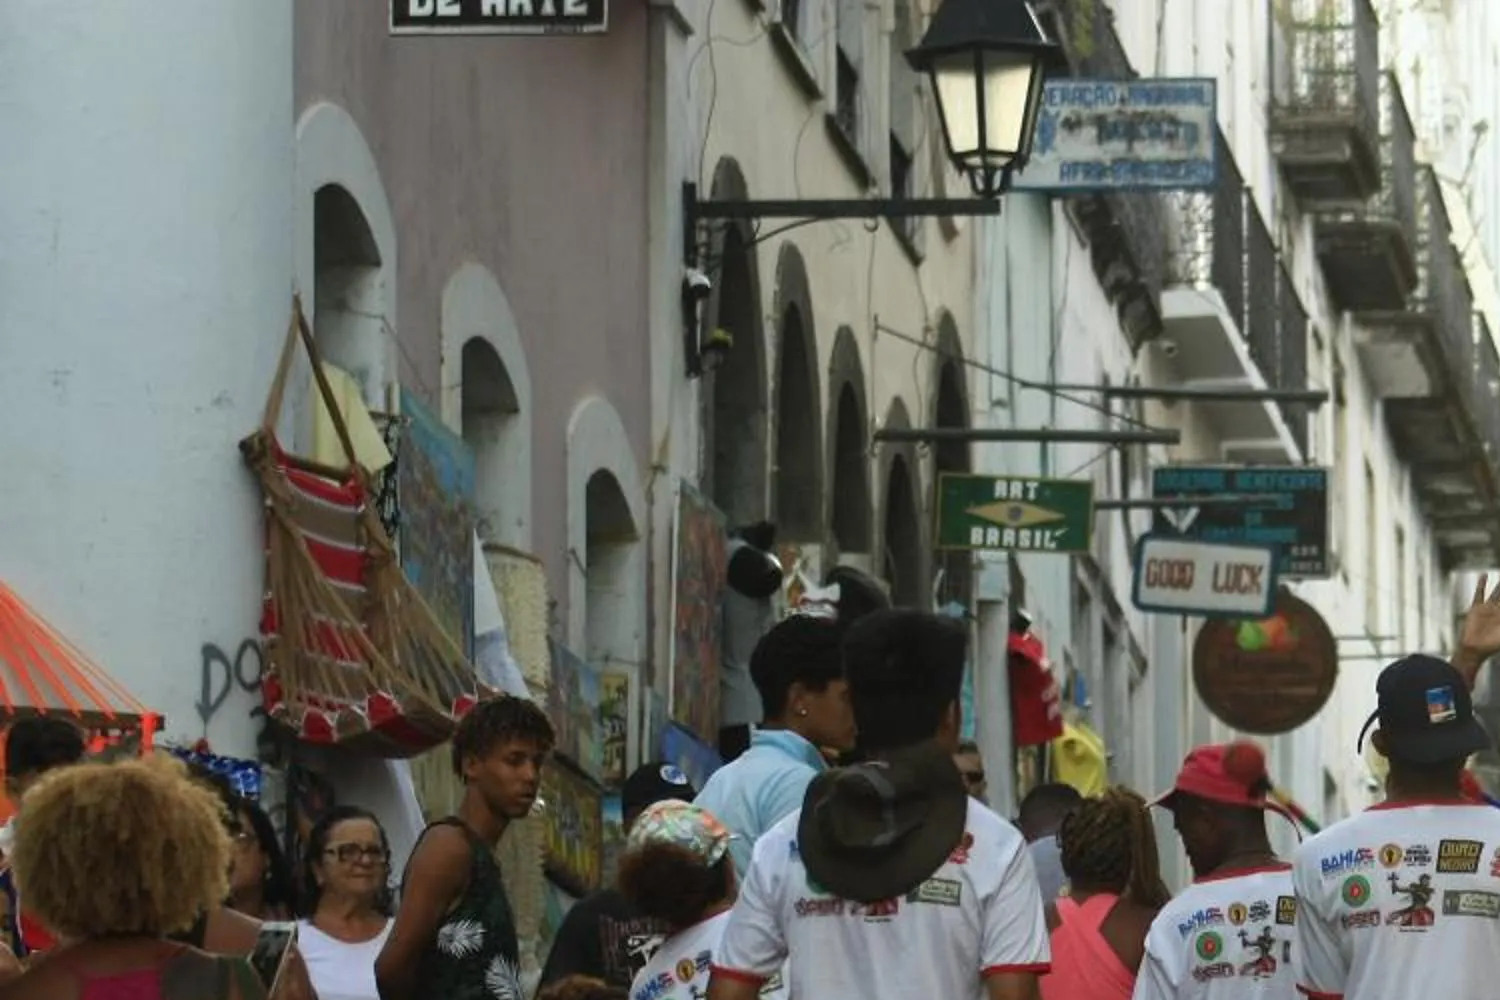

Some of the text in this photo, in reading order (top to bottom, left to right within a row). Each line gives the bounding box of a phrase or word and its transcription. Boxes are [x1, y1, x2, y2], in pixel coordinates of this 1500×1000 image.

[409, 0, 461, 17] DE
[994, 480, 1038, 498] ART
[970, 527, 1056, 549] BRASIL
[1146, 557, 1263, 594] GOOD LUCK
